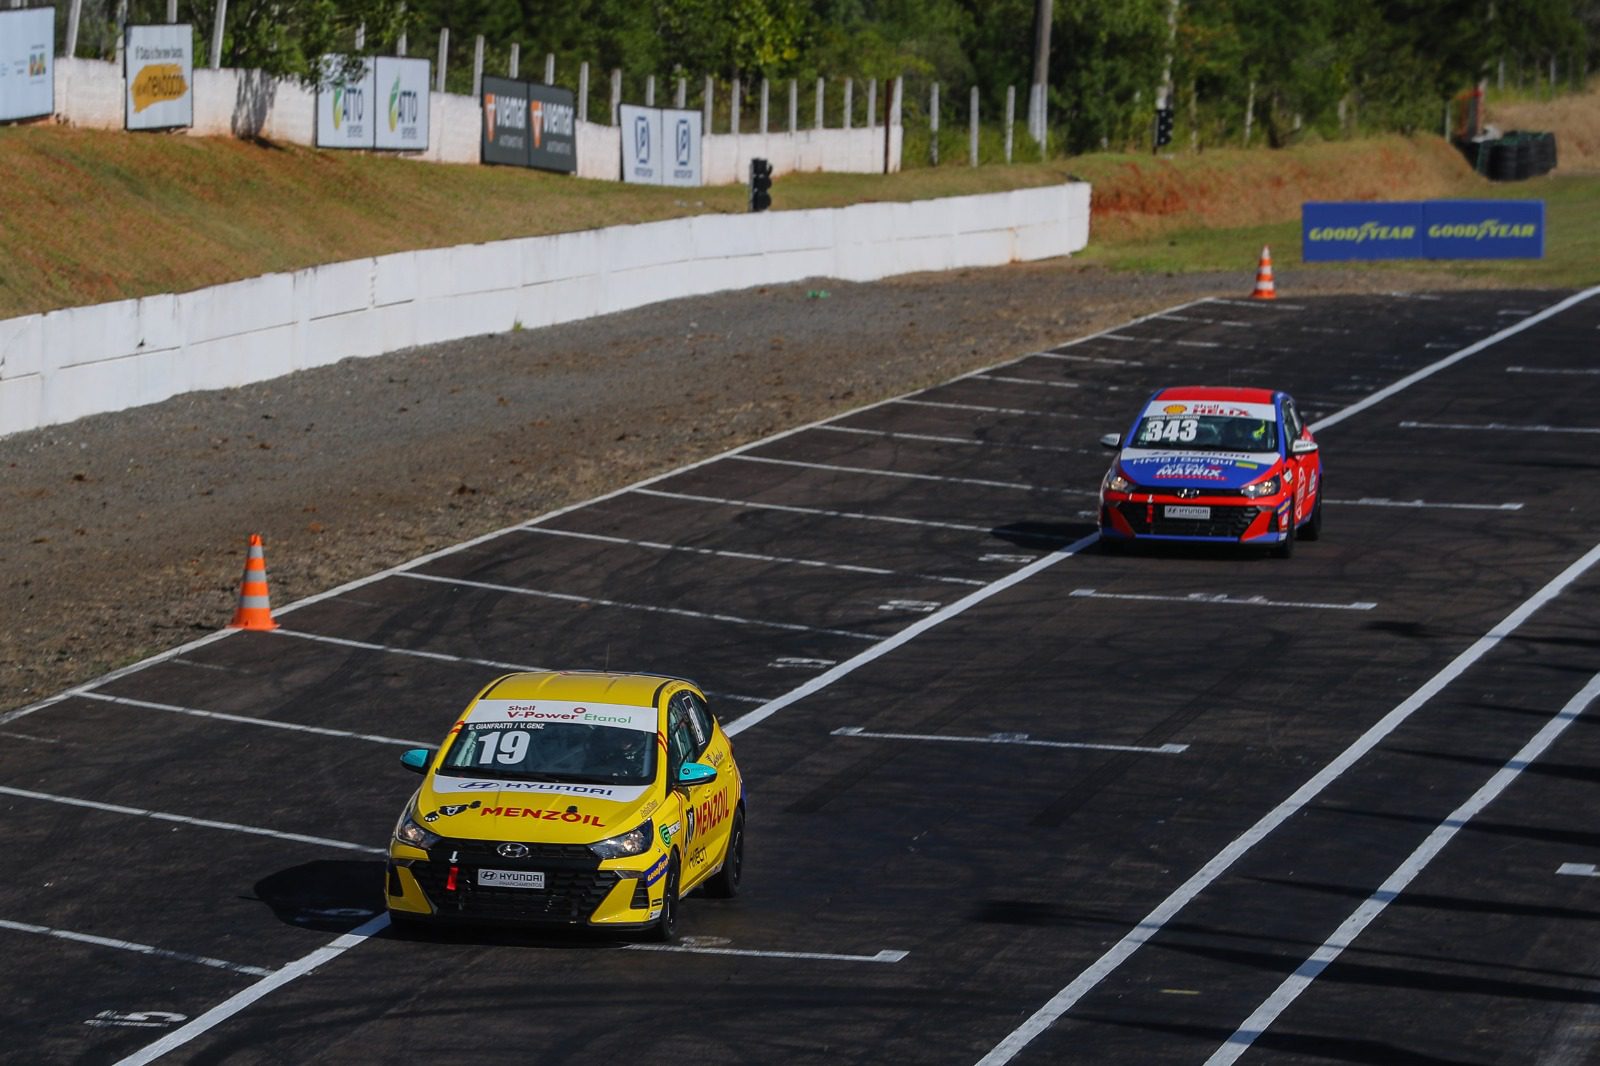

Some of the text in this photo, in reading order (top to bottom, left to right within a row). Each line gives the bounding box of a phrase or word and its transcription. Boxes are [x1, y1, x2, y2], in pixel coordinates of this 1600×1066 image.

[1309, 221, 1417, 243] GOODYEAR
[1427, 218, 1537, 240] GOODYEAR
[1192, 408, 1251, 417] HELIX
[1145, 420, 1199, 442] 343
[1156, 467, 1222, 477] MATRIX
[507, 711, 579, 720] V-Power
[584, 713, 632, 724] Etanol
[478, 730, 531, 765] 19
[506, 783, 613, 796] HYUNDAI
[480, 806, 606, 827] MENZOIL
[695, 786, 730, 839] MENZOIL
[499, 873, 543, 882] HYUNDAI
